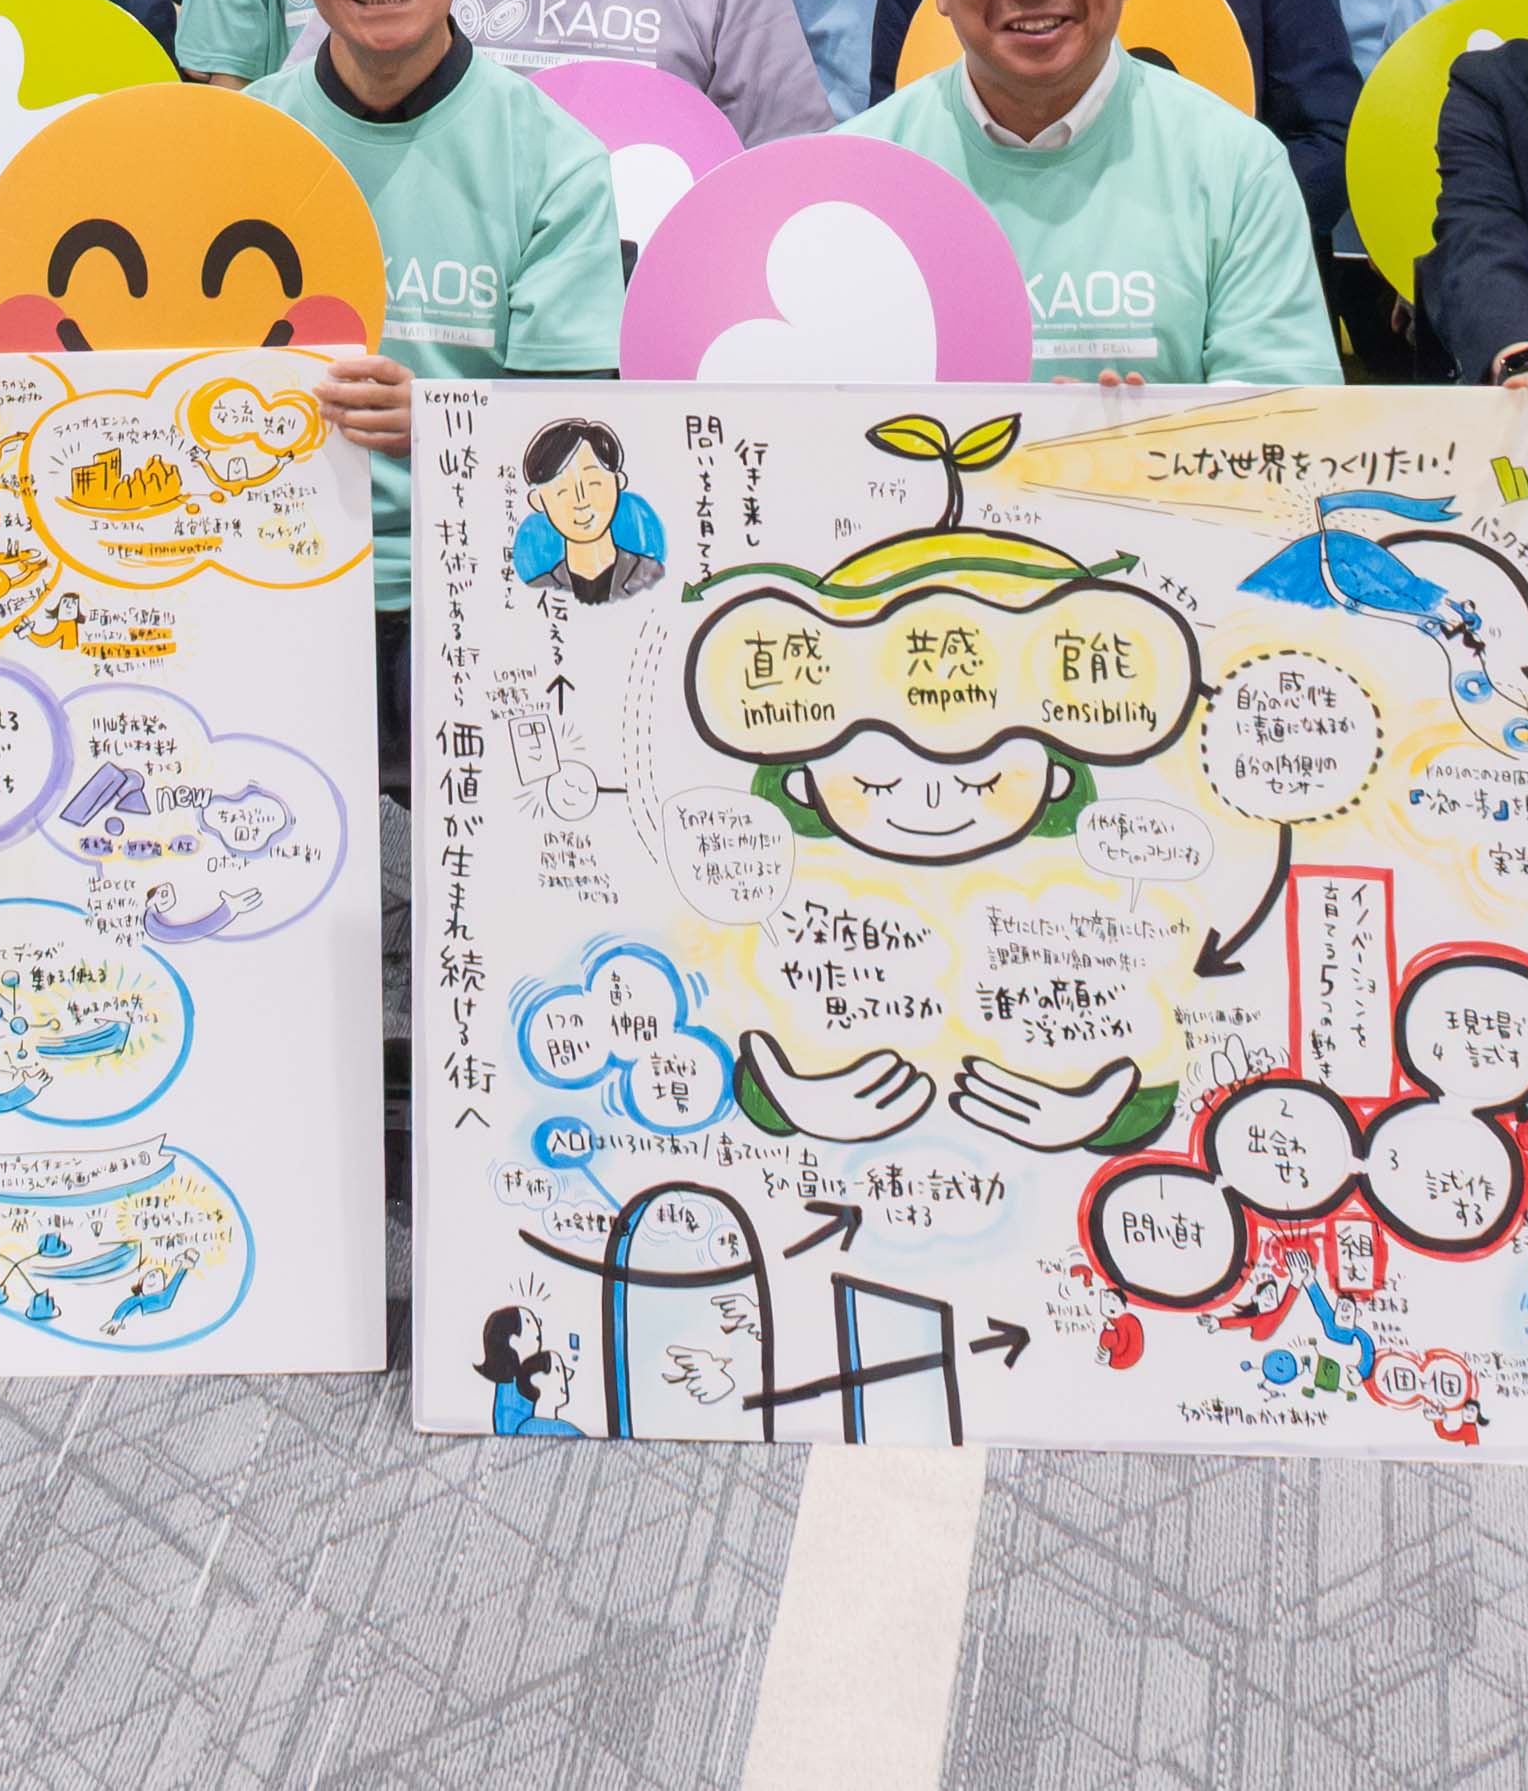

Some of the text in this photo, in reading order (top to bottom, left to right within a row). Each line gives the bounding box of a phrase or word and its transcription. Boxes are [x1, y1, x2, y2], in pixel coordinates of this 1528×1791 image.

[423, 389, 490, 407] Keynote
[1146, 442, 1457, 484] こんな世界をつくりたい!
[684, 414, 724, 582] 問いを育てる
[536, 589, 569, 665] 伝える
[743, 629, 831, 690] 直感
[906, 626, 984, 680] 共感
[1054, 631, 1138, 685] 官能
[741, 697, 835, 729] intuition
[906, 684, 998, 709] empathy
[155, 783, 213, 812] new
[779, 959, 886, 994] やりたいと
[609, 1014, 659, 1044] 仲間
[824, 994, 944, 1031] 思っているか
[1247, 1126, 1308, 1156] 出会わ
[1425, 1170, 1496, 1202] 試作
[1122, 1212, 1205, 1247] 問い直す
